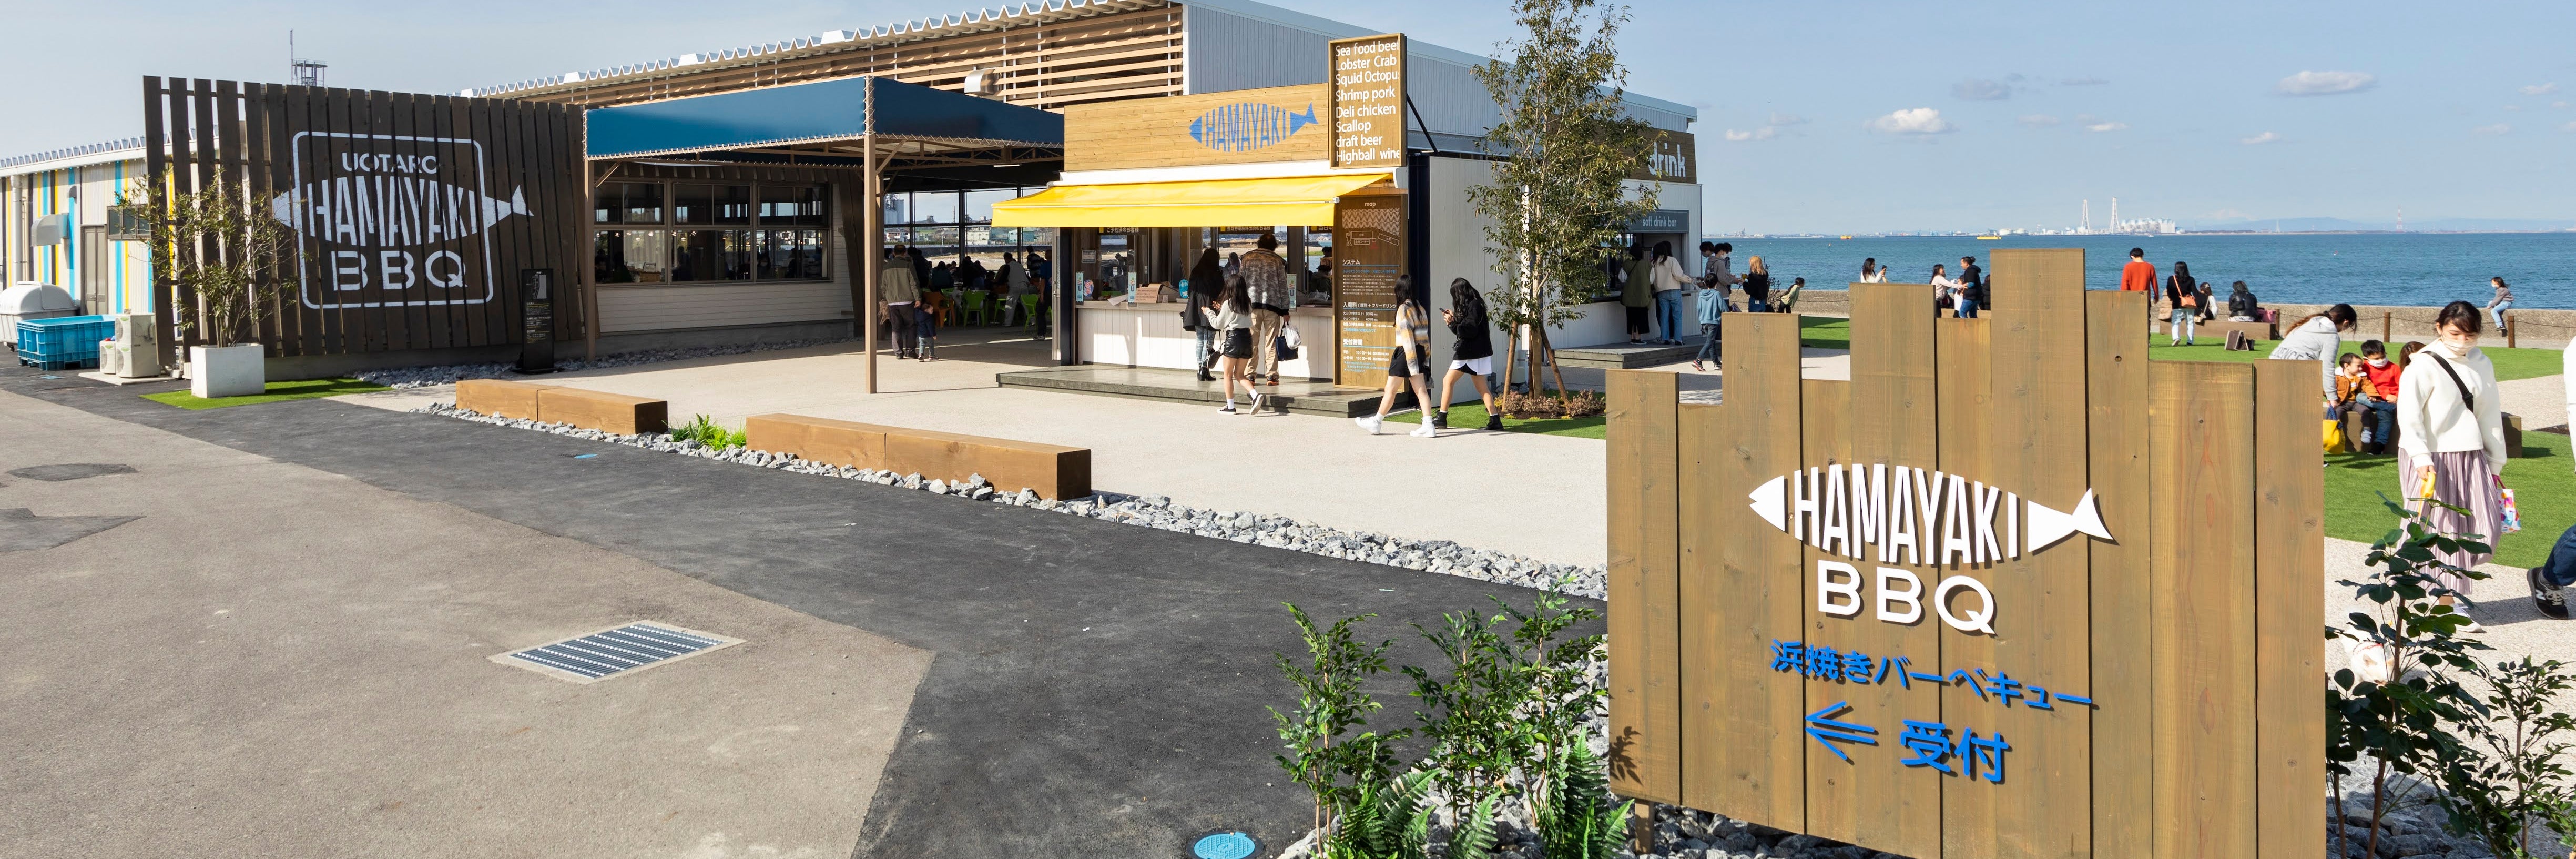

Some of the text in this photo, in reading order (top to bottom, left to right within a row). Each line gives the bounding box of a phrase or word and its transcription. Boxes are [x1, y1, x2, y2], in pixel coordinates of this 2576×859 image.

[1336, 45, 1351, 57] Sea
[1354, 41, 1376, 55] food
[1336, 54, 1397, 71] Lobster Crab
[1336, 71, 1362, 87] Squid
[1336, 85, 1396, 102] Shrimp pork
[1336, 103, 1396, 118] Deli chicken
[1206, 103, 1286, 152] HAMAYAKI
[1336, 119, 1371, 134] Scallop
[1336, 134, 1383, 147] draft beer
[1336, 147, 1400, 165] Highball wine
[1648, 142, 1686, 177] drink
[307, 176, 477, 246] HAMAYAKI
[1643, 216, 1677, 227] soft drink bar
[331, 250, 467, 291] BBQ
[1794, 463, 2018, 565] HAMAYAKI
[1818, 560, 1995, 634] BBQ
[1770, 639, 2092, 709] 浜焼きバーベキュー
[1900, 720, 2009, 782] 受付
